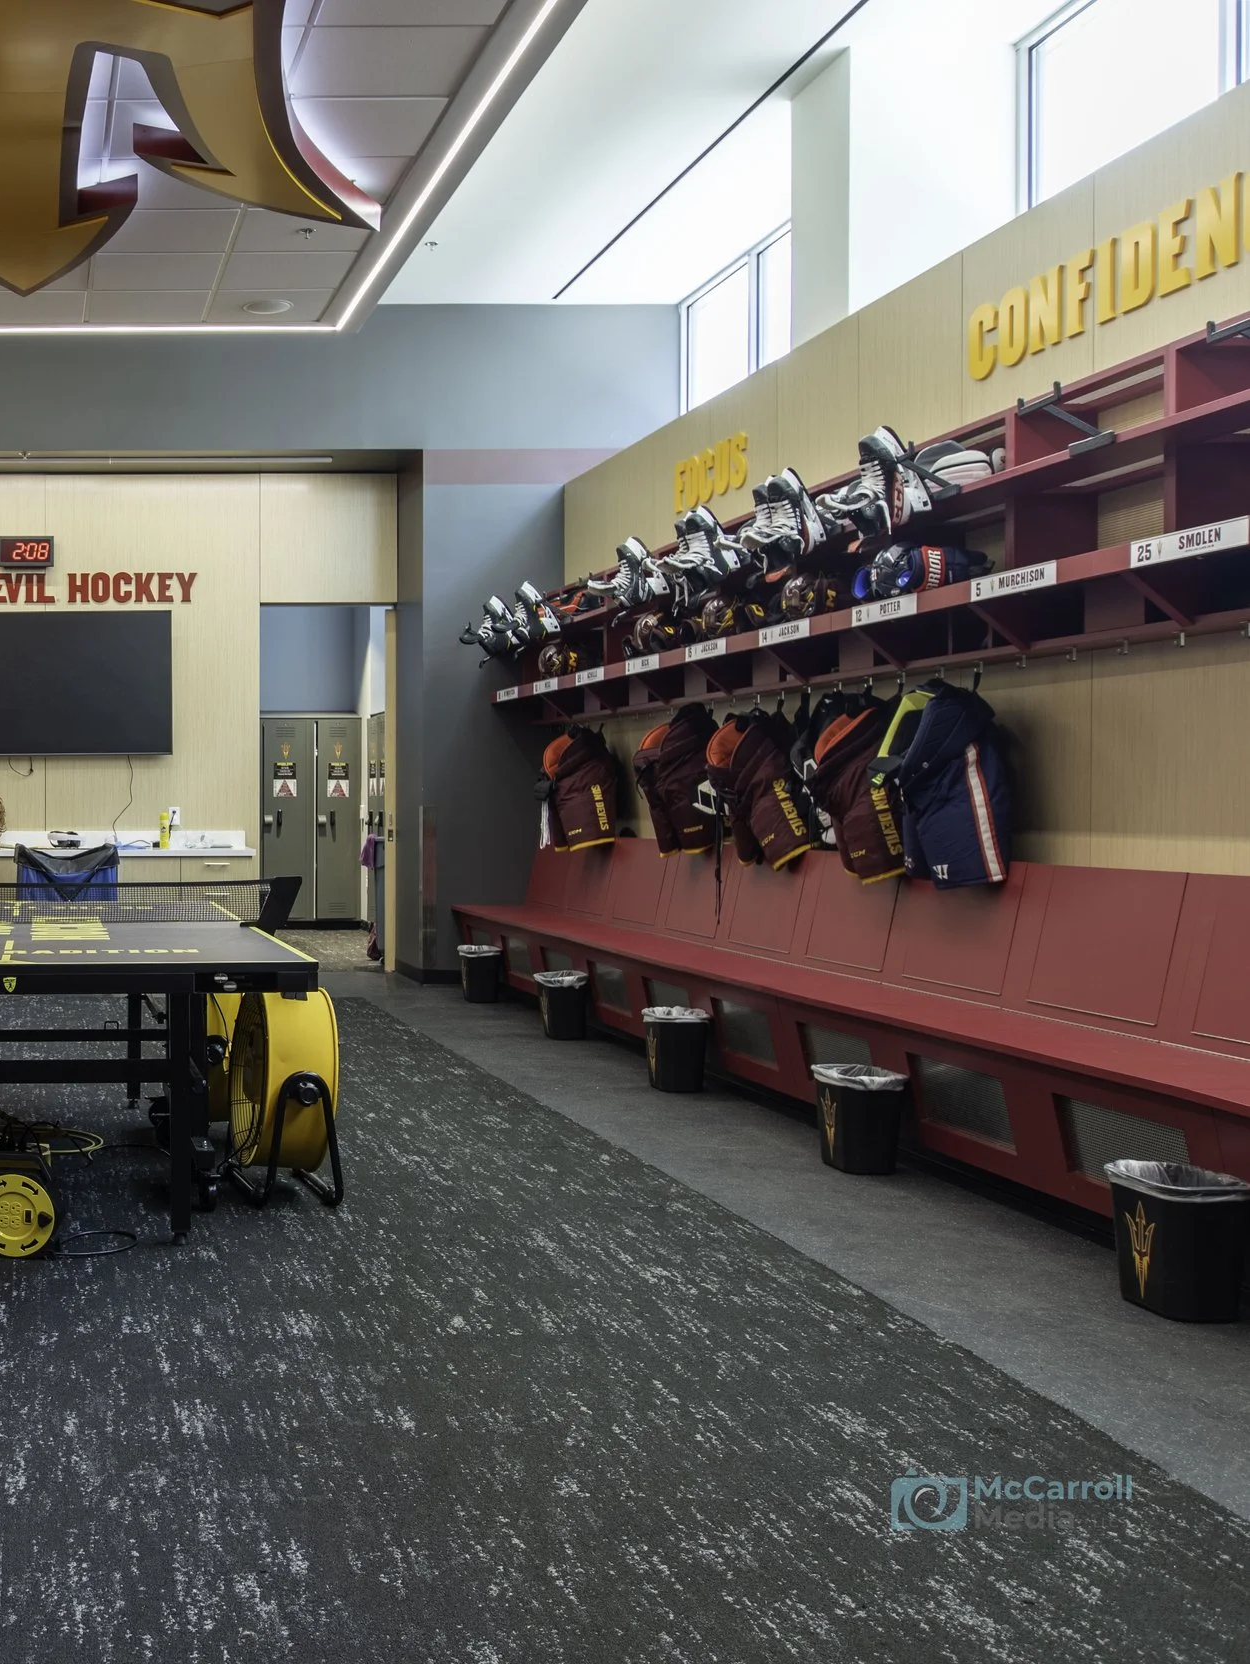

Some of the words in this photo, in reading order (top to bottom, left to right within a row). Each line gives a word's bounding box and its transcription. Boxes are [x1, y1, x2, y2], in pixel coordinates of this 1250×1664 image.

[968, 171, 1250, 382] CONFIDEN
[673, 431, 748, 514] FOCUS
[12, 542, 49, 560] 2:08
[1136, 545, 1152, 563] 25
[1178, 527, 1222, 550] SMOLEN
[67, 572, 198, 604] HOCKEY
[975, 582, 981, 597] 5
[997, 567, 1046, 590] MURCHISON
[855, 609, 862, 622] 12
[879, 600, 901, 615] POTTER
[778, 623, 800, 637] JACKSON
[596, 801, 609, 831] DEVILS
[780, 799, 807, 837] DEVILS
[877, 811, 903, 856] DEVILS
